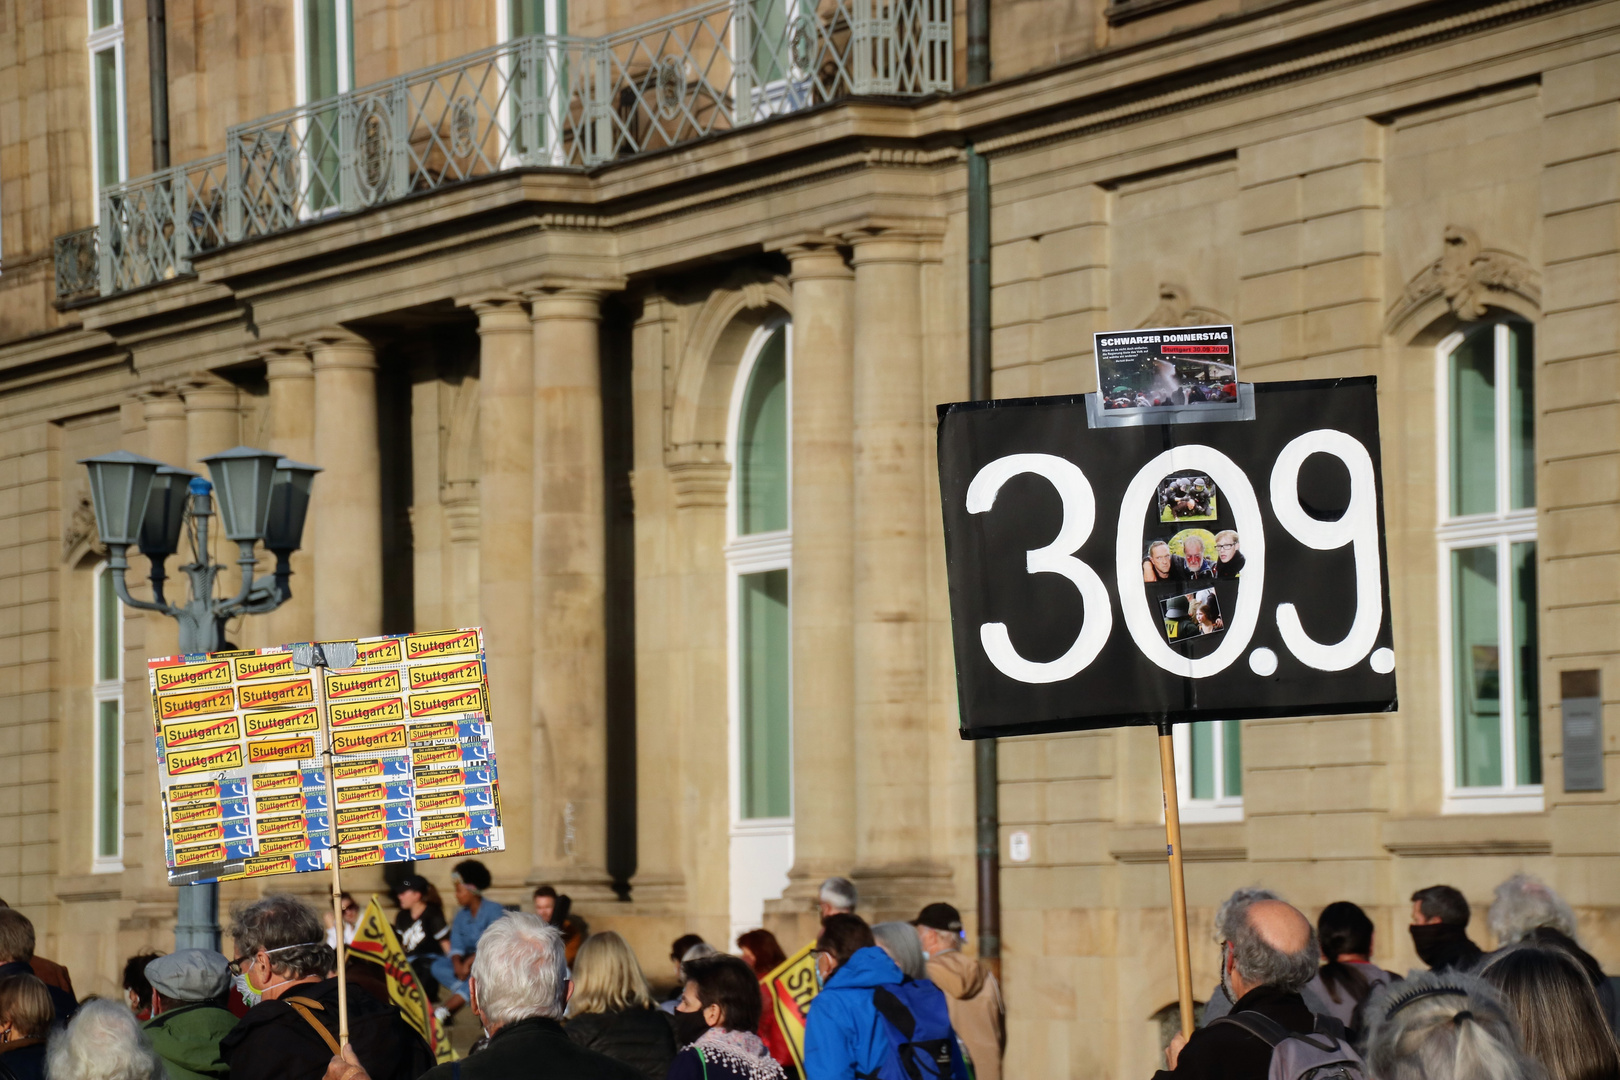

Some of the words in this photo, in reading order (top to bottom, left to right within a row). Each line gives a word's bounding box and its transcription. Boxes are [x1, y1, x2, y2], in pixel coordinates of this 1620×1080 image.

[1101, 335, 1161, 347] SCHWARZER
[1163, 332, 1228, 343] DONNERSTAG
[1163, 346, 1191, 354] Stuttgart
[966, 429, 1395, 683] 30.9.
[386, 646, 397, 656] 21
[411, 638, 461, 653] Stuttgart
[463, 636, 474, 647] 21
[240, 660, 291, 674] Stuttgart
[414, 669, 463, 683] Stuttgart
[466, 667, 477, 677] 21
[161, 668, 213, 684] Stuttgart
[215, 667, 226, 678] 21
[332, 678, 382, 692] Stuttgart
[385, 676, 396, 686] 21
[243, 688, 295, 702] Stuttgart
[297, 686, 309, 696] 21
[165, 696, 217, 712] Stuttgart
[219, 695, 230, 706] 21
[414, 696, 464, 711] Stuttgart
[467, 695, 477, 705] 21
[335, 706, 385, 721] Stuttgart
[388, 704, 399, 715] 21
[249, 715, 301, 729] Stuttgart
[303, 714, 314, 725] 21
[170, 725, 221, 741] Stuttgart
[224, 723, 234, 734] 21
[338, 734, 388, 748] Stuttgart
[391, 731, 402, 742] 21
[253, 746, 298, 757] Stuttgart
[300, 744, 310, 753] 21
[172, 753, 224, 770] Stuttgart
[226, 752, 238, 762] 21
[788, 968, 813, 1019] Stu
